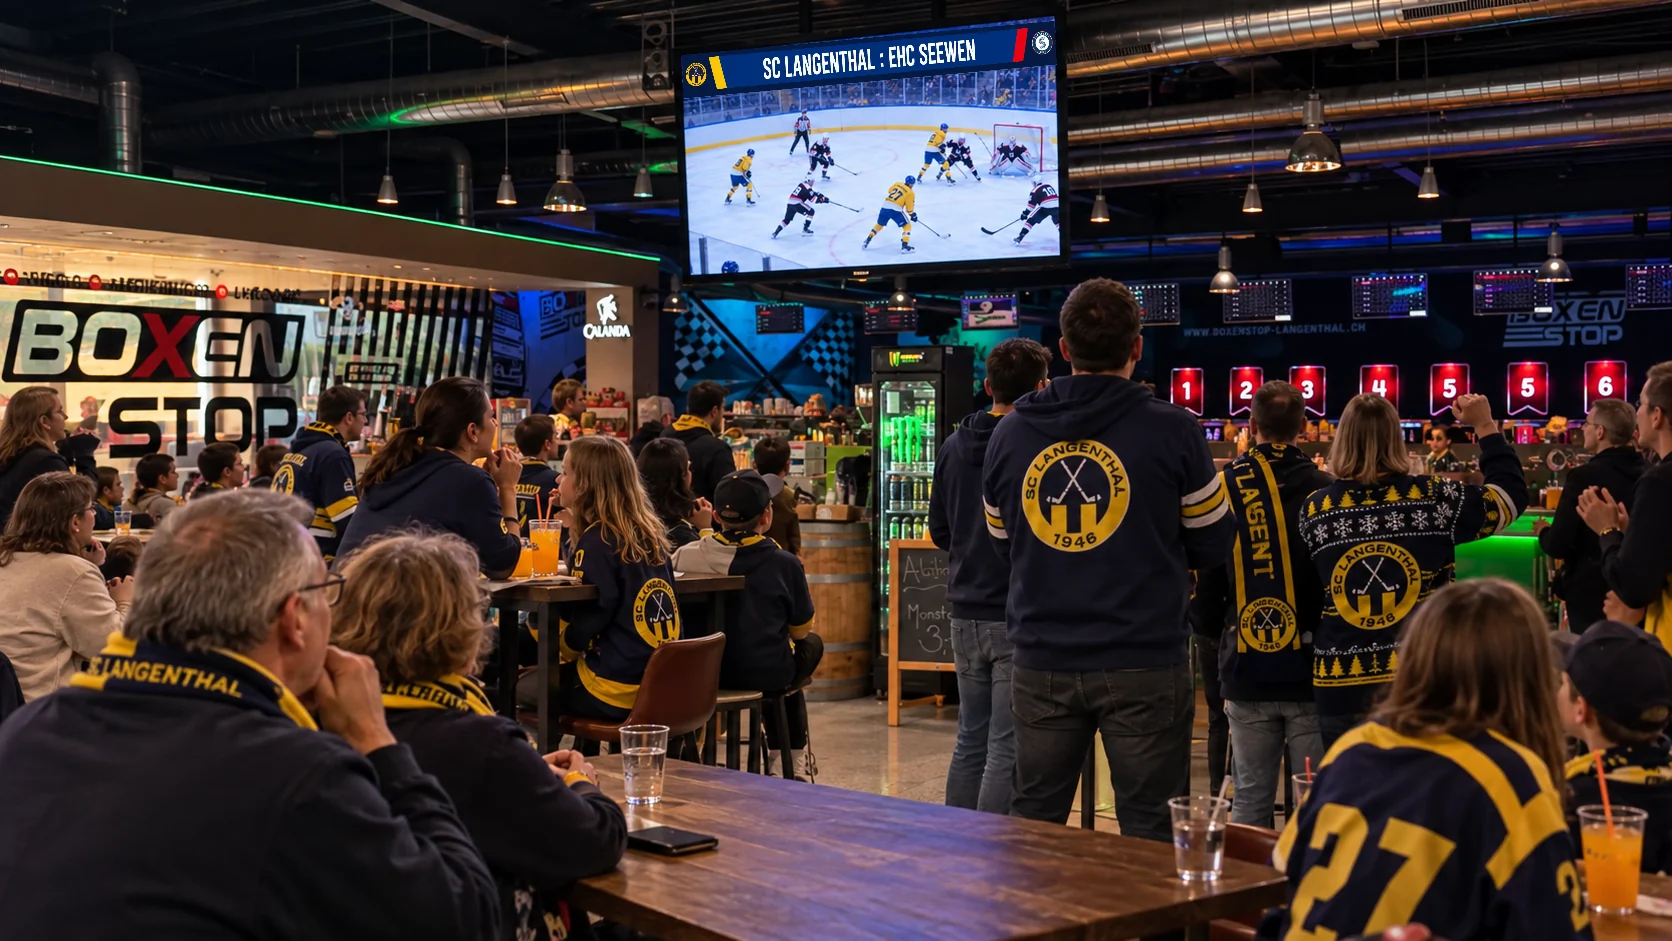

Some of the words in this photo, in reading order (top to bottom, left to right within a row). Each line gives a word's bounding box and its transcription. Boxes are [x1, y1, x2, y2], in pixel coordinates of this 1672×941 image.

[763, 56, 781, 80] SC
[785, 48, 876, 78] LANGENTHAL
[888, 44, 916, 68] EHC
[919, 38, 977, 66] SEEWEN
[888, 187, 904, 201] 27
[583, 323, 631, 340] CALANDA
[1541, 325, 1624, 346] STOP
[12, 308, 299, 379] BOXEN
[1181, 381, 1191, 400] 1
[1239, 380, 1253, 400] 2
[1301, 380, 1314, 399] 3
[1371, 379, 1387, 398] 4
[1442, 378, 1457, 398] 5
[1520, 377, 1535, 398] 5
[1597, 376, 1613, 396] 6
[109, 397, 298, 459] STOP
[1025, 476, 1038, 500] SC
[1033, 442, 1126, 498] LANGENTHAL
[1053, 532, 1097, 548] 1946
[1332, 574, 1343, 595] SC
[1338, 544, 1419, 586] LANGENTHAL
[102, 657, 243, 698] LANGENTHAL
[1283, 803, 1457, 941] 27
